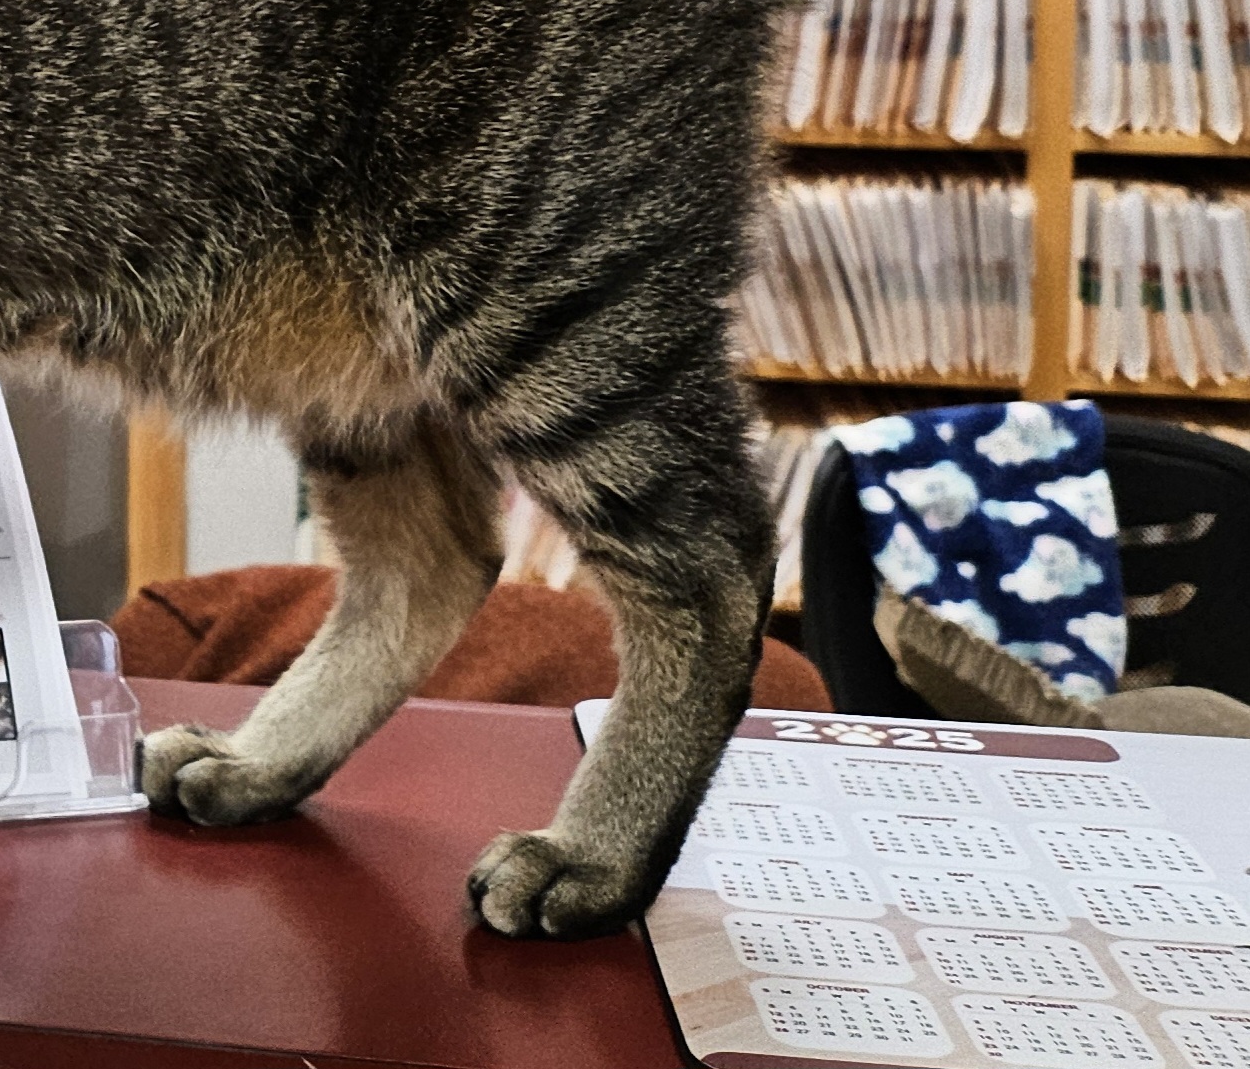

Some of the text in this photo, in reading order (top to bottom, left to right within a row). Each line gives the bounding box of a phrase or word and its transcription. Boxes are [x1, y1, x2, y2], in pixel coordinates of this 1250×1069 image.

[974, 933, 1025, 941] AUGUST
[1153, 945, 1234, 956] SEPTEMBER
[806, 983, 871, 994] OCTOBER
[1002, 999, 1079, 1011] NOVEMBER
